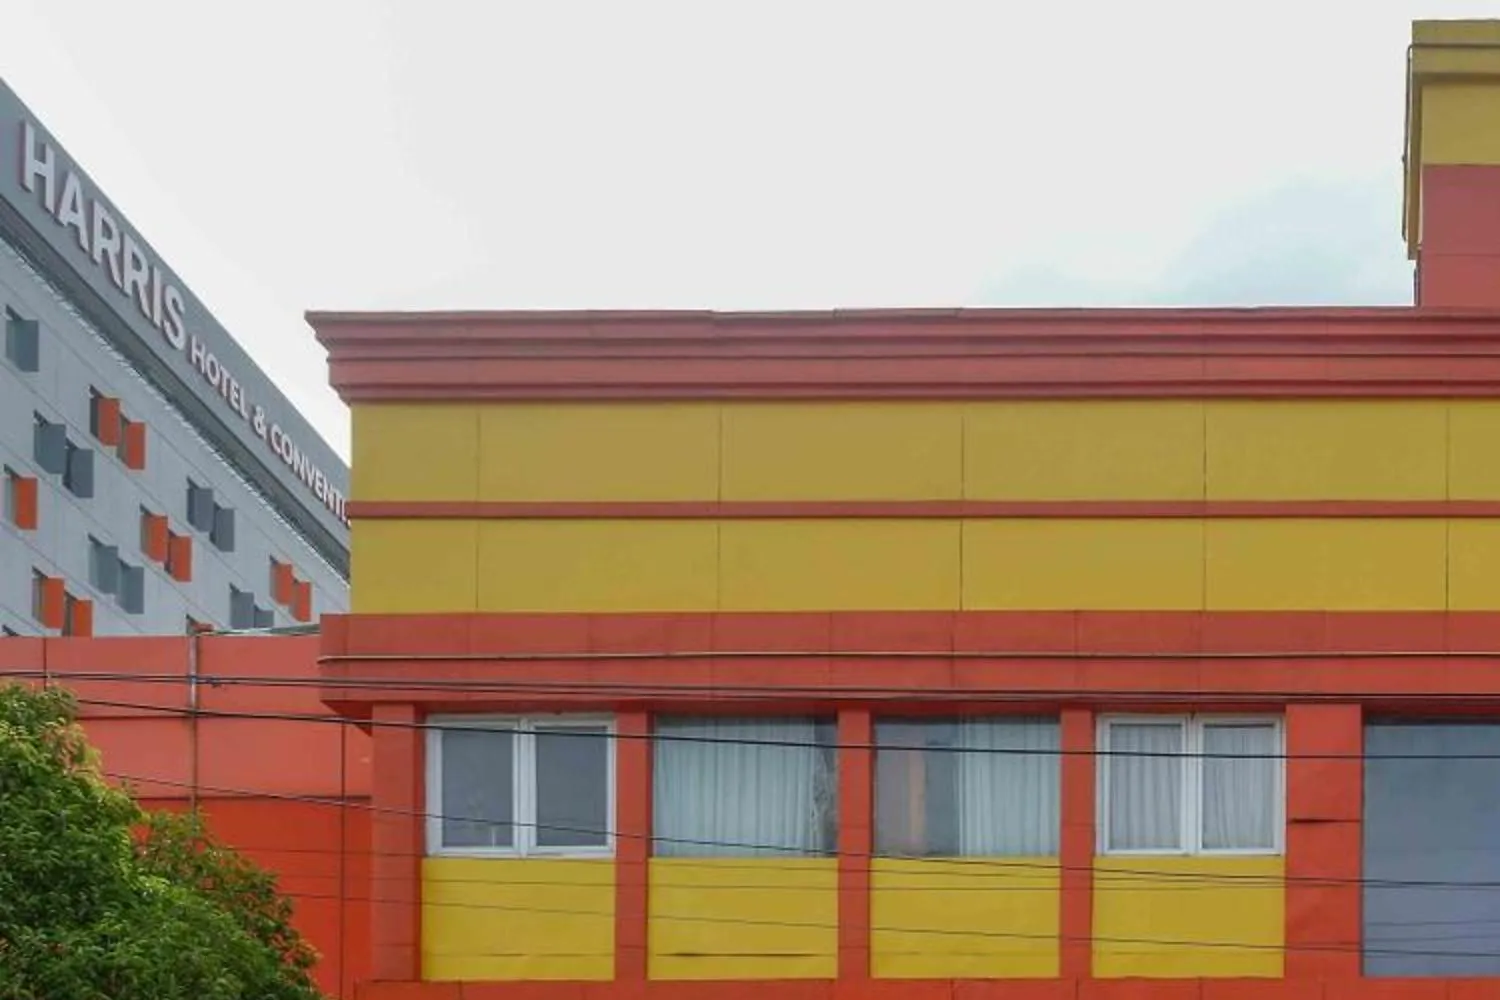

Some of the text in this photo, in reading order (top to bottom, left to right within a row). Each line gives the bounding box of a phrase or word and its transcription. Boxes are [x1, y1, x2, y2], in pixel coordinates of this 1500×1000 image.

[21, 120, 351, 527] HARRIS HOTEL & CONVENTI
